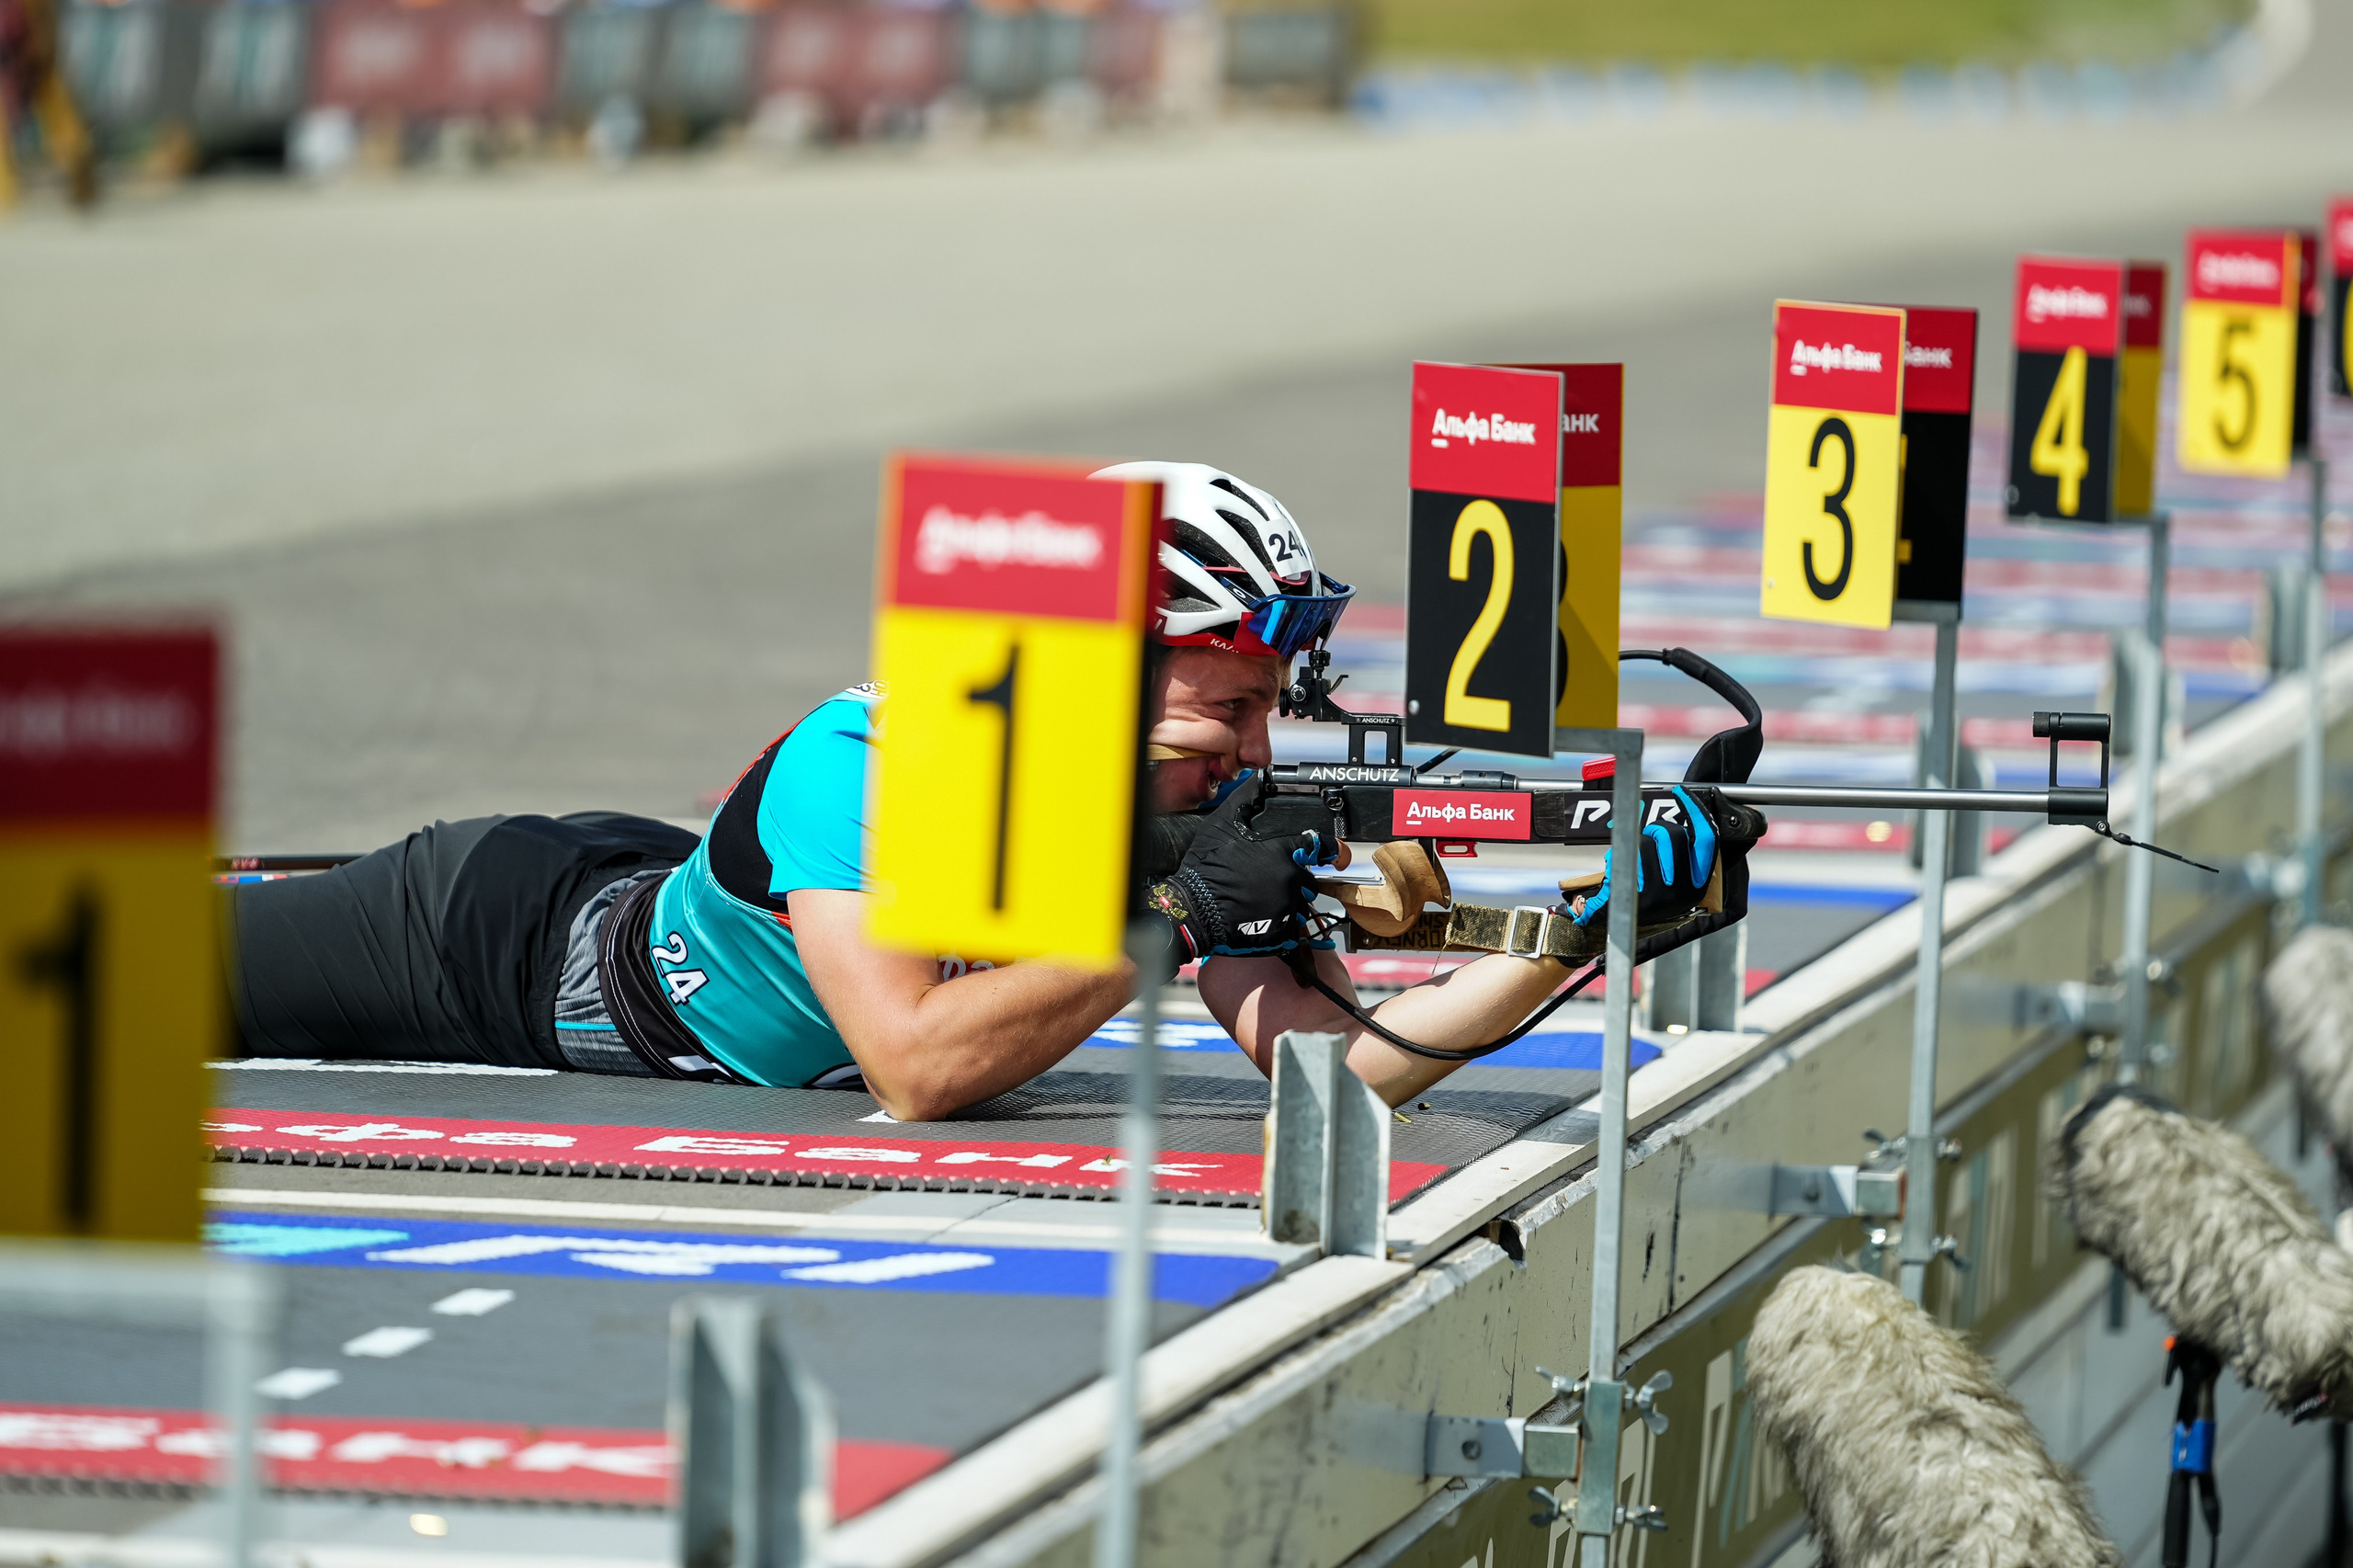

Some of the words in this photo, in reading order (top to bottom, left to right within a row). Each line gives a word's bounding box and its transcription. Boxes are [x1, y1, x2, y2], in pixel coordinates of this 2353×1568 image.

[1432, 408, 1490, 447] Альфа
[1491, 414, 1536, 445] Банк
[1561, 414, 1599, 433] анк
[2030, 346, 2089, 516] 4
[2215, 318, 2258, 454] 5
[1268, 530, 1303, 562] 24
[1802, 417, 1856, 601] 3
[1444, 499, 1515, 733] 2
[960, 634, 1020, 914] 1
[1406, 801, 1467, 824] Альфа
[1470, 803, 1516, 821] Банк
[651, 930, 710, 1006] 24
[14, 878, 103, 1229] 1
